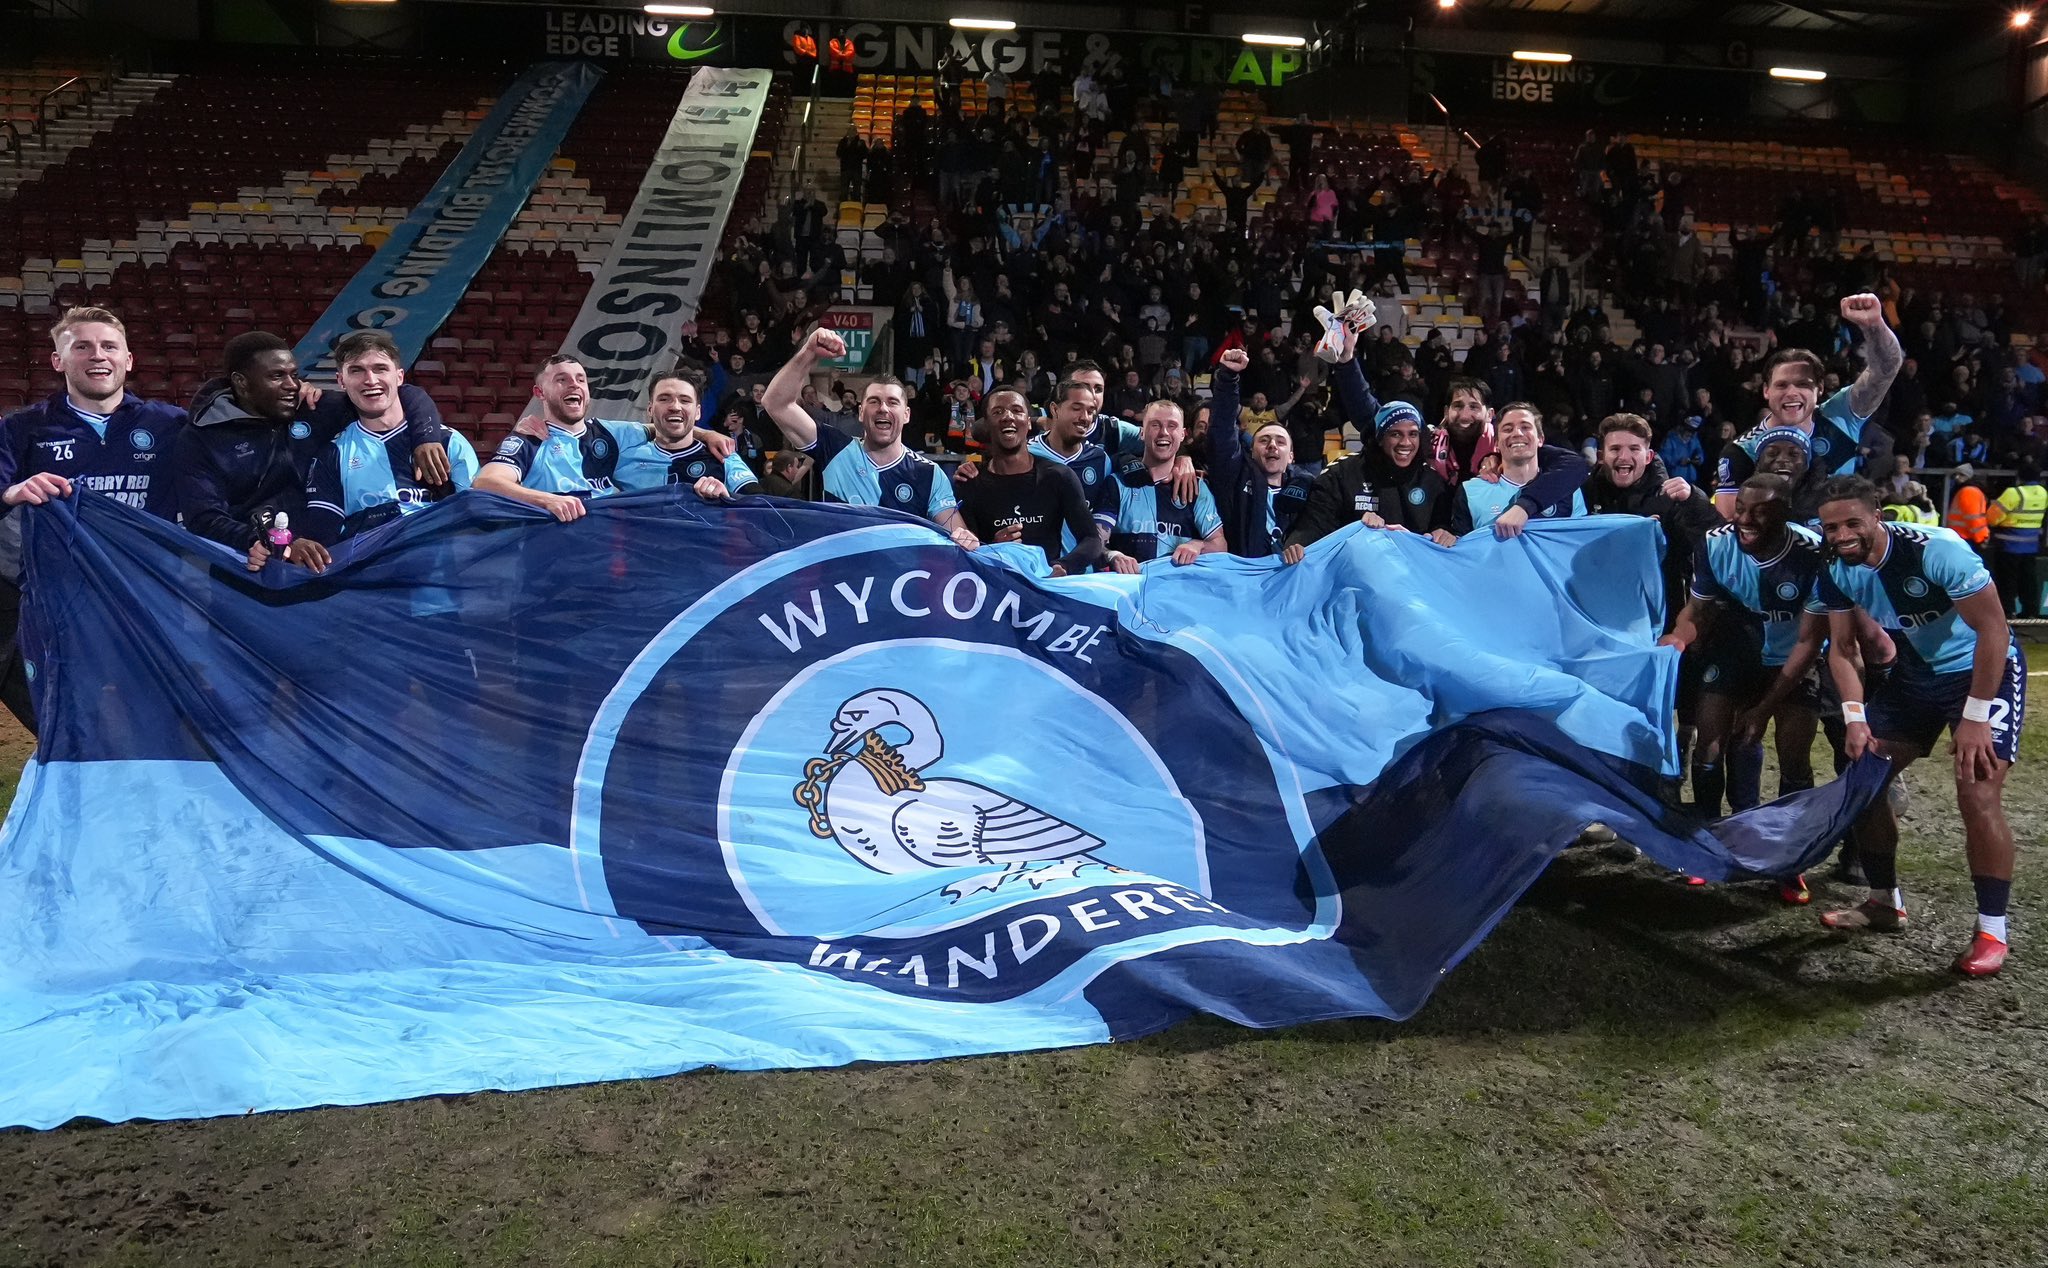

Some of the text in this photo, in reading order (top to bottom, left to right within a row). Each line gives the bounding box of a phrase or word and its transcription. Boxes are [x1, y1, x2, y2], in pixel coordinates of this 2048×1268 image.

[546, 11, 669, 37] LEADING
[546, 35, 619, 57] EDGE
[1493, 61, 1595, 83] LEADING
[1492, 82, 1554, 102] EDGE
[377, 193, 492, 298] BUILDING
[577, 142, 739, 401] TOMLINSON
[833, 314, 858, 327] V40
[837, 331, 871, 348] XIT
[52, 445, 74, 461] 26
[126, 475, 151, 490] RED
[993, 515, 1044, 527] CATAPULT
[758, 569, 1112, 665] WYCOMBE
[808, 885, 1232, 988] WANDERE
